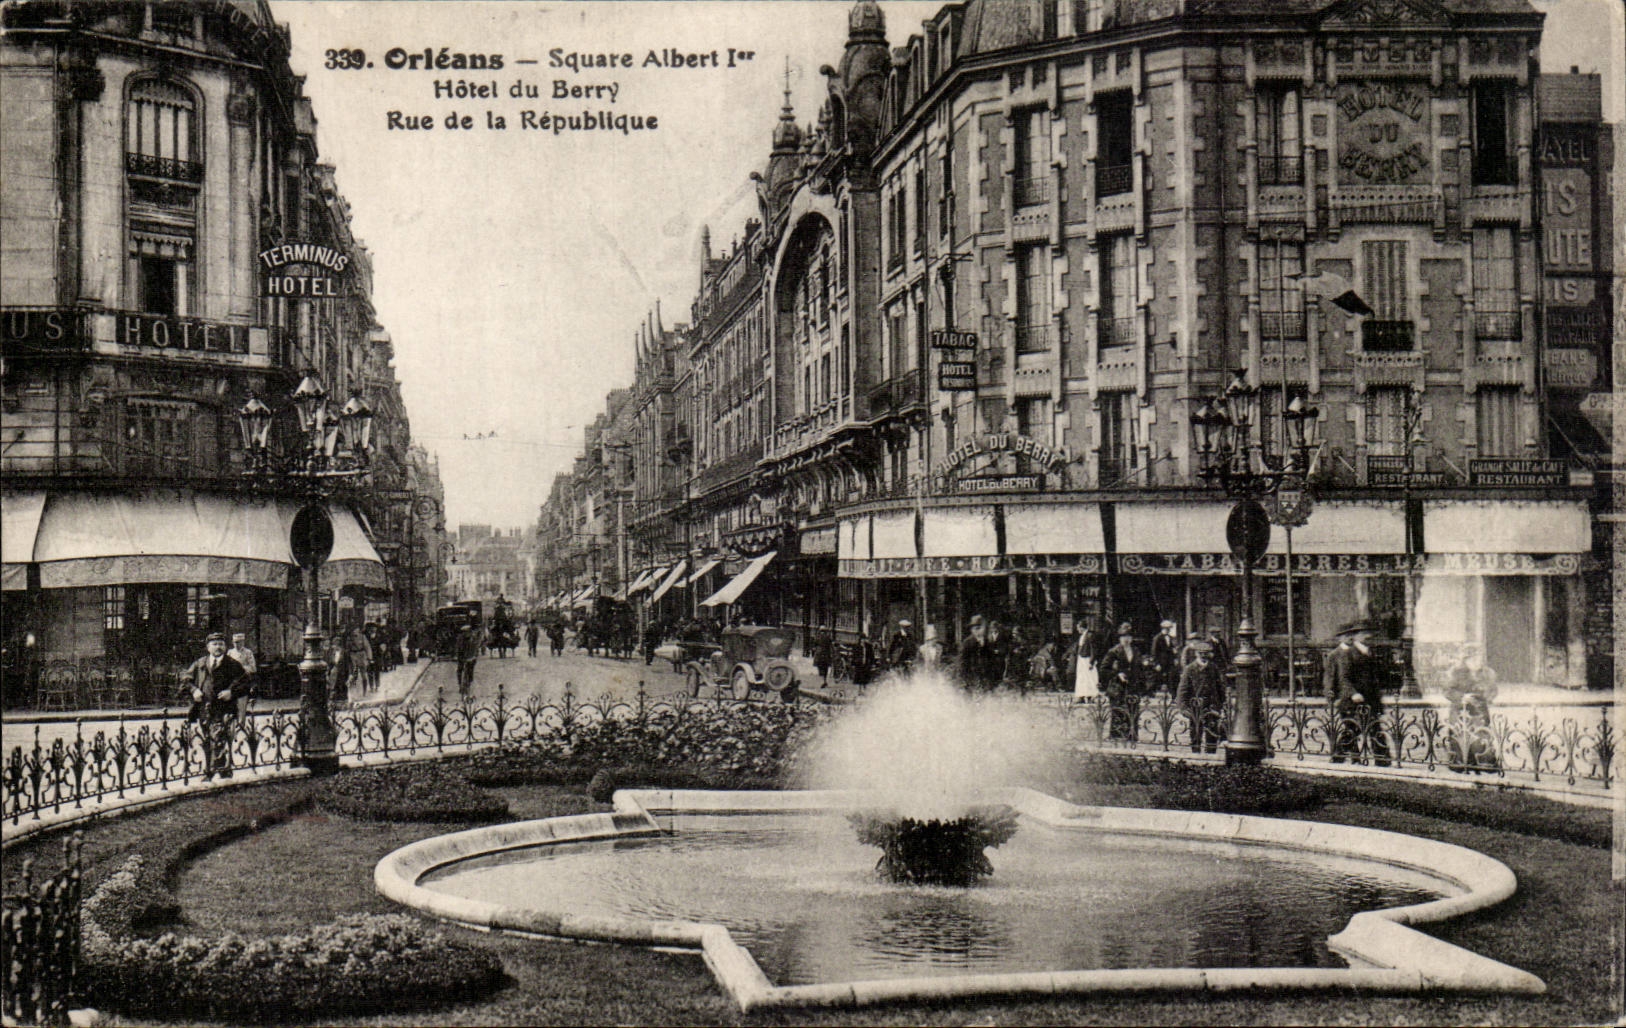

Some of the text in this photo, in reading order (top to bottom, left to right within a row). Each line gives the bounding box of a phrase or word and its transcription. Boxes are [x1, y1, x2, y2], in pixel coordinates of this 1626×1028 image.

[1368, 121, 1400, 143] DU
[260, 244, 349, 273] TERMINUS
[268, 277, 337, 296] HOTEL
[124, 317, 249, 352] HOTEL
[933, 332, 975, 347] TABAC
[942, 364, 974, 375] HOTEL
[940, 434, 1061, 473] HOTEL DU BERRY
[959, 479, 989, 491] HOTEL
[1477, 474, 1563, 485] RESTAURANT
[1443, 554, 1536, 570] MEUSE
